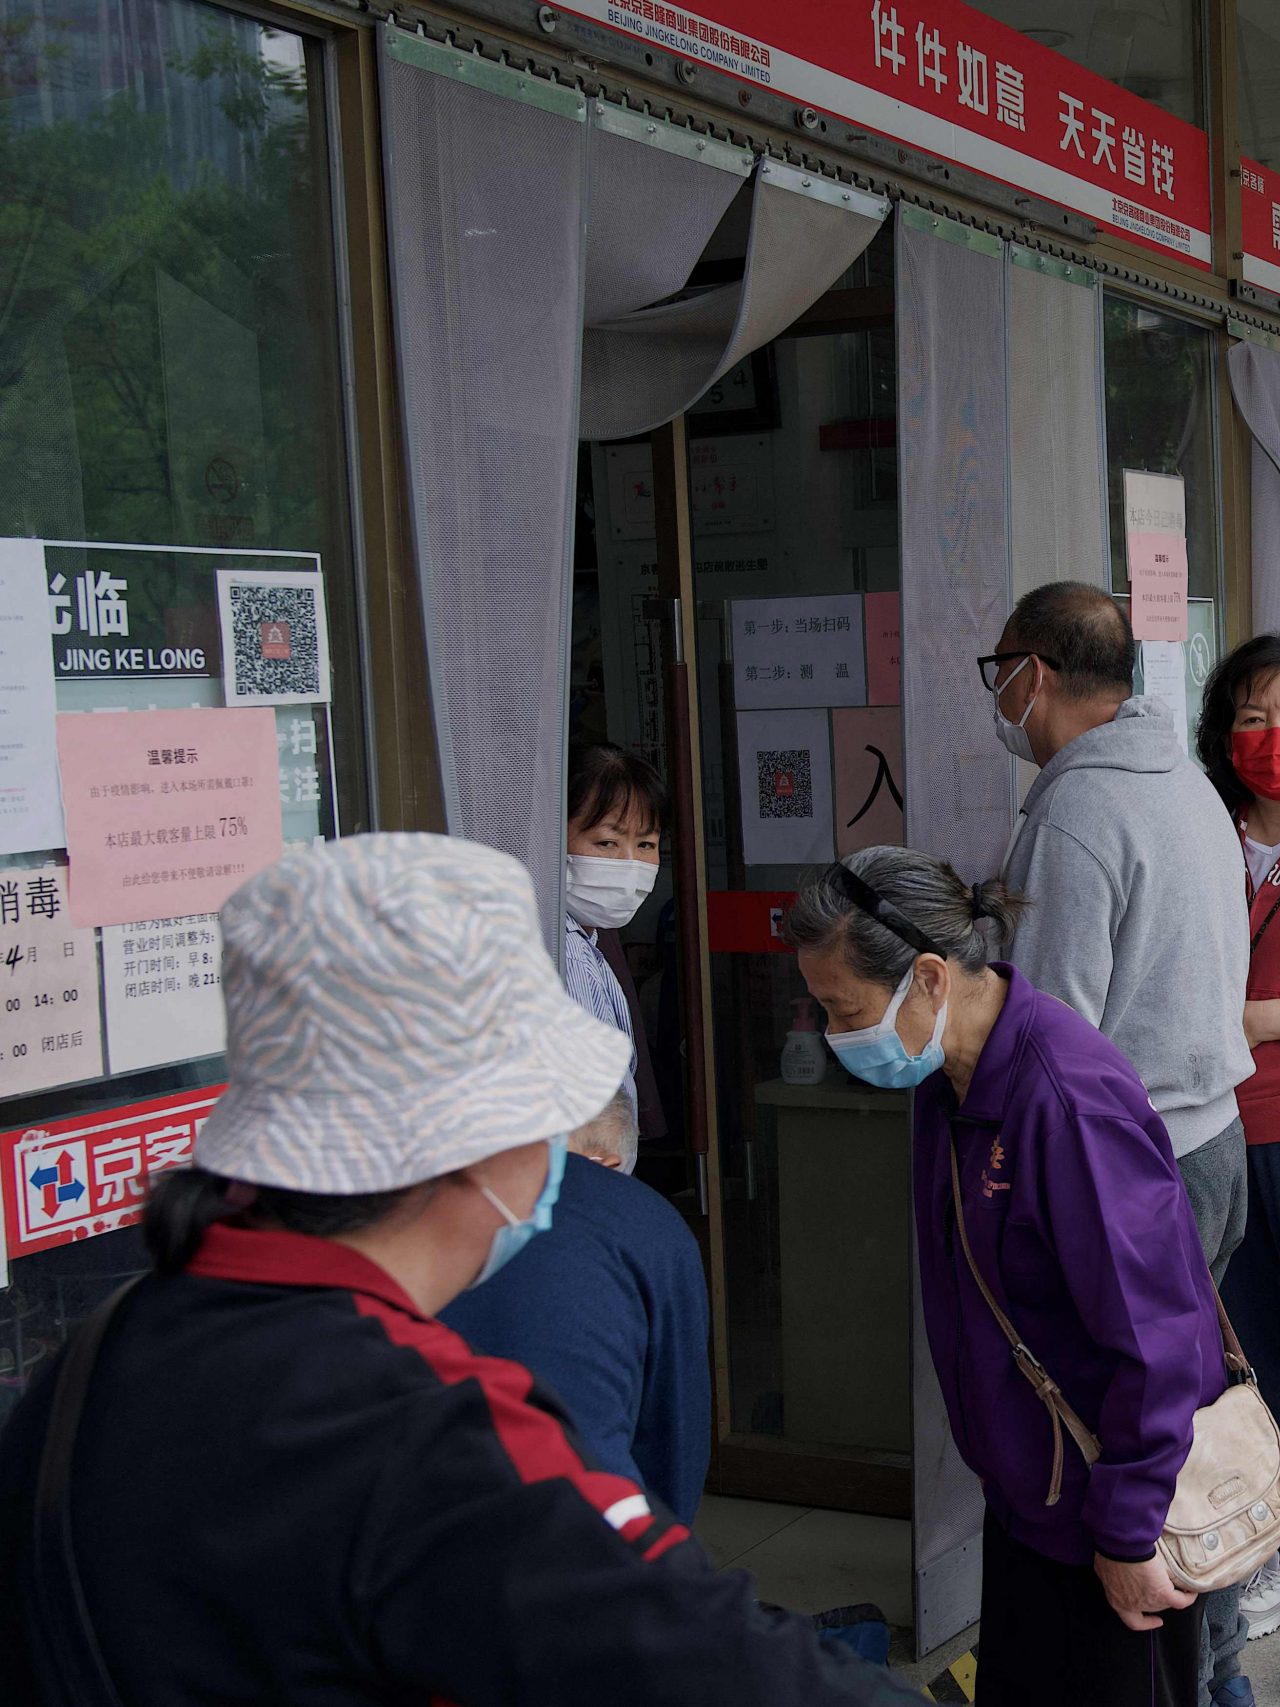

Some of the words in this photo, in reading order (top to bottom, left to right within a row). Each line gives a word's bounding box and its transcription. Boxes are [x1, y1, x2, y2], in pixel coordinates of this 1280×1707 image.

[608, 9, 643, 33] BEIJING
[645, 25, 699, 55] JINGKELONG
[700, 46, 739, 71] COMPANY
[740, 62, 771, 83] LIMITED
[870, 0, 1026, 133] 件件如意
[1058, 90, 1176, 202] 天天省钱
[59, 647, 111, 672] JING
[115, 648, 147, 671] KE
[149, 647, 206, 670] LONG
[147, 748, 199, 766] 温馨提示
[41, 1030, 84, 1053] 闭店后
